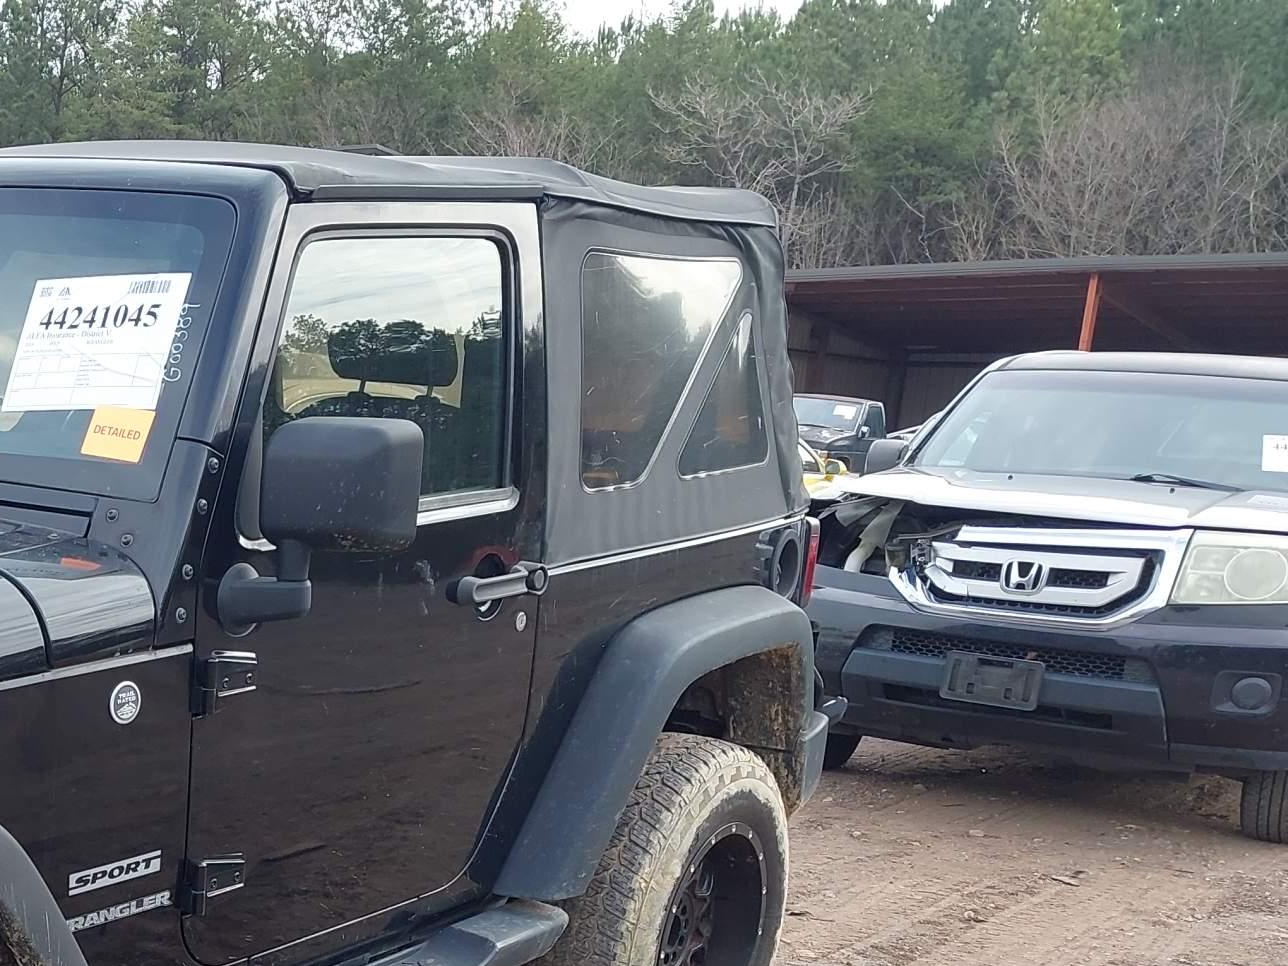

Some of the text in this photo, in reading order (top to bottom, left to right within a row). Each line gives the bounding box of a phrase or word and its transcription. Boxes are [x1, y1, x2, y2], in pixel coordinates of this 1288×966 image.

[40, 304, 162, 330] 44241045
[93, 424, 141, 441] DETAILED
[75, 857, 157, 888] SPORT
